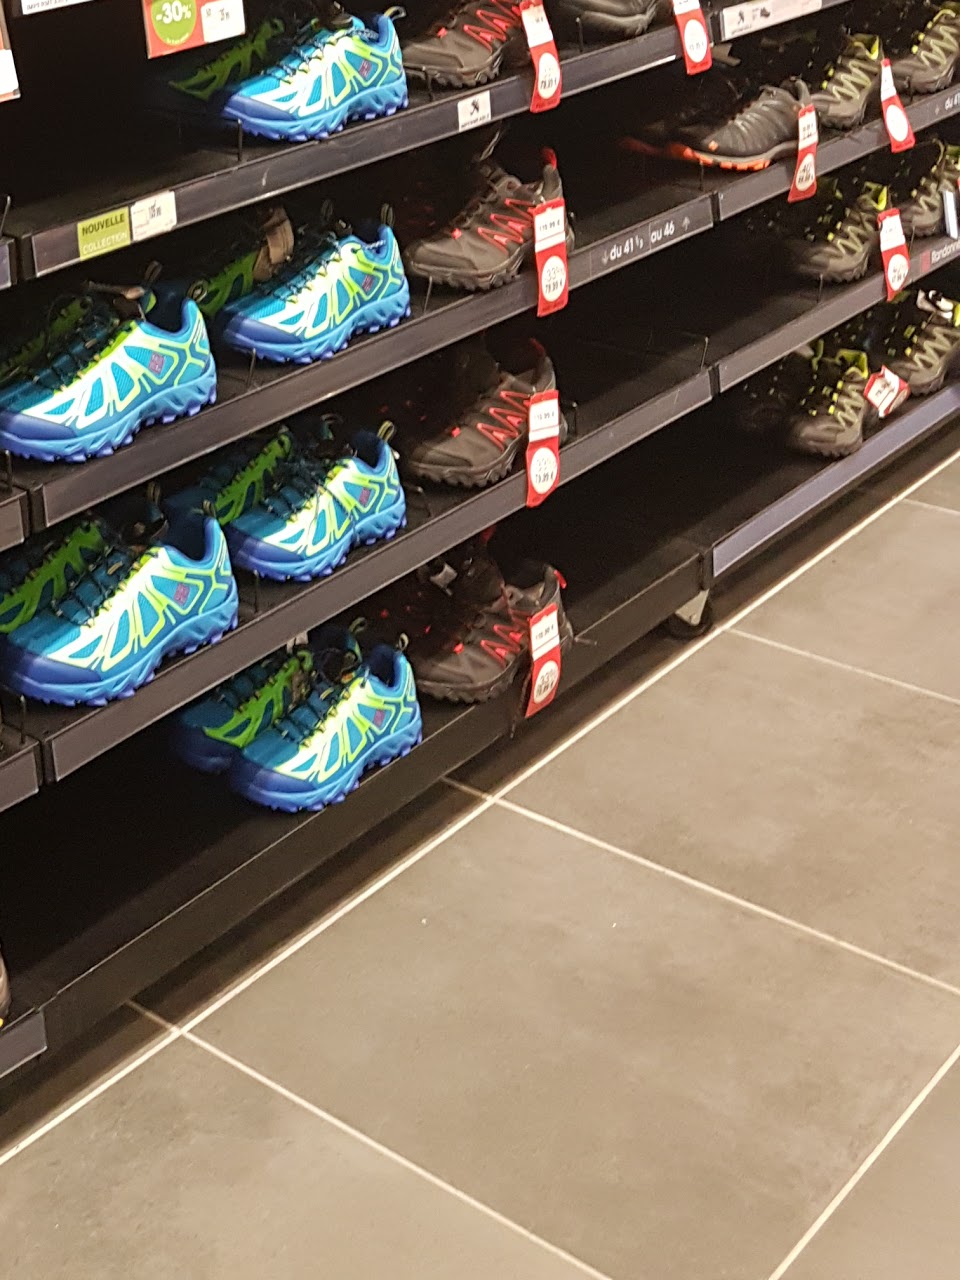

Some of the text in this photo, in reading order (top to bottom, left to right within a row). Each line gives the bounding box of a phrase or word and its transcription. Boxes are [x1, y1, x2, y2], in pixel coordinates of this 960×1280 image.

[82, 213, 126, 237] NOUVELLE
[83, 231, 128, 253] COLLECTION
[609, 244, 622, 260] du
[623, 238, 634, 254] 41
[650, 229, 663, 243] au
[663, 220, 675, 237] 46
